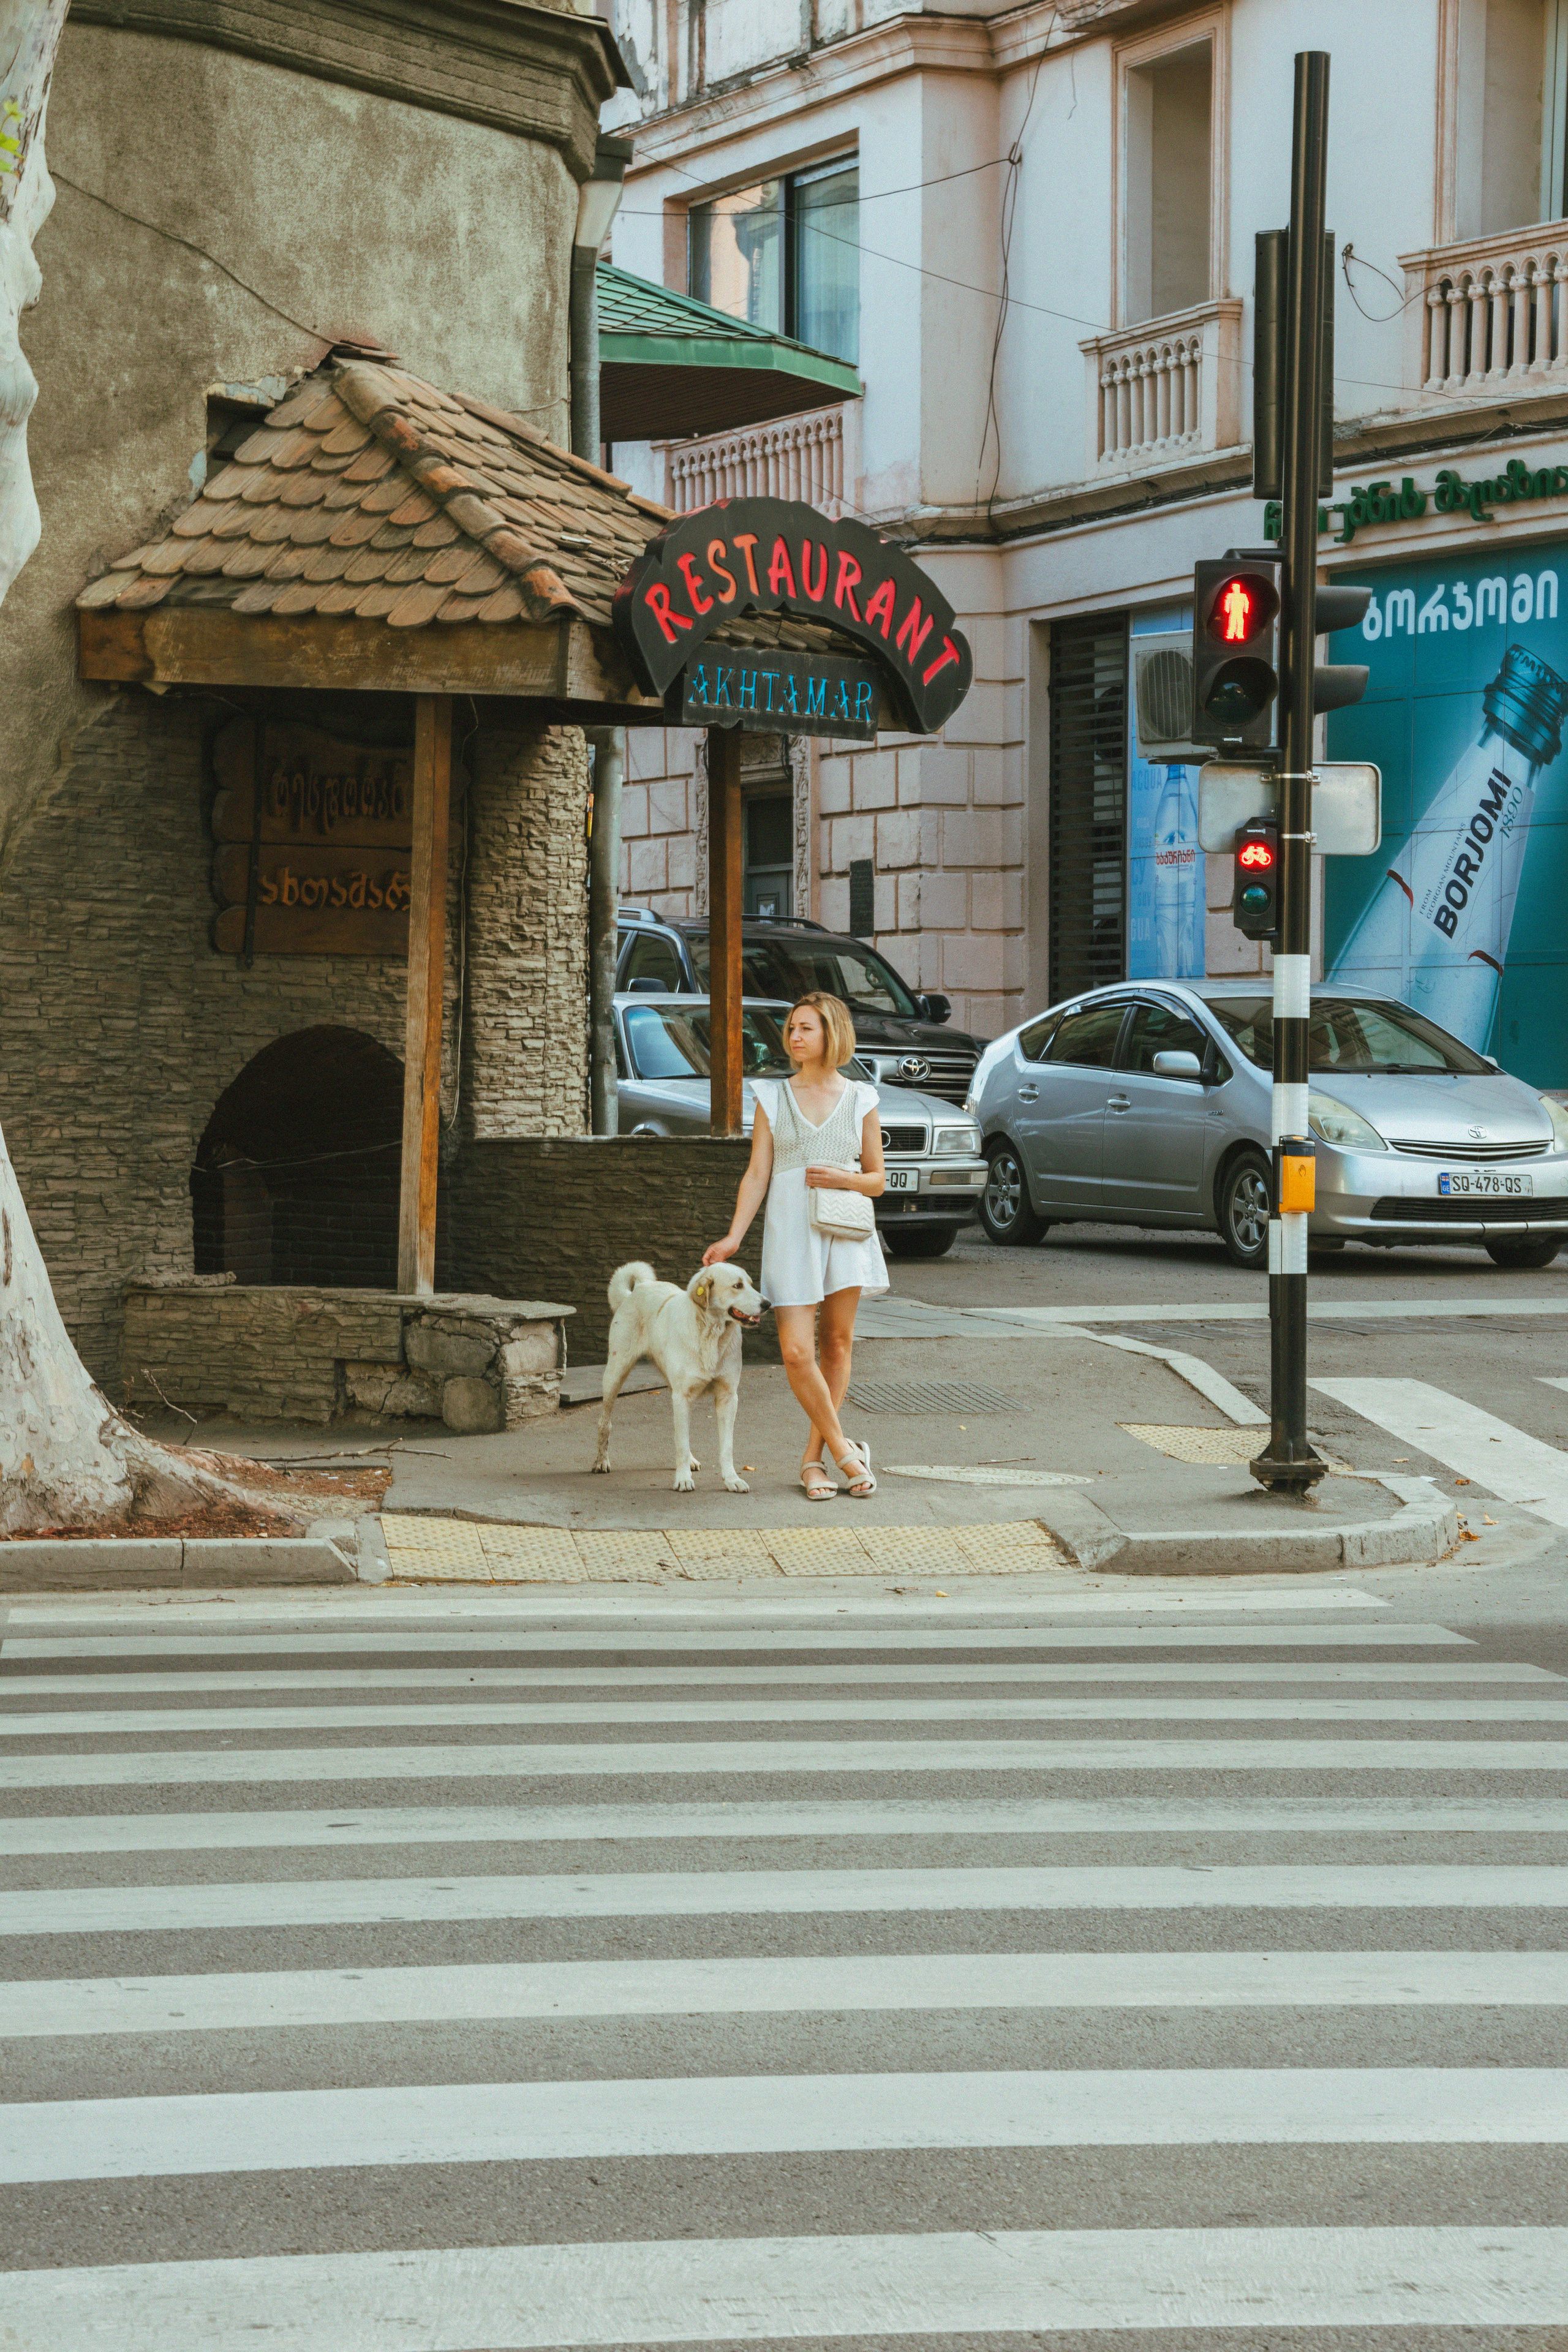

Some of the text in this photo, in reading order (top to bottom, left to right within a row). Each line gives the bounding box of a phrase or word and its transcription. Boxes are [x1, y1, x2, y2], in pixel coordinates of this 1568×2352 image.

[645, 533, 960, 686] RESTAURANT
[688, 663, 873, 723] AKHTAMAR
[1500, 786, 1523, 839] 1890
[1156, 849, 1196, 865] ბაკურიანი
[1427, 822, 1466, 919] GEORGIAN MOUNTAINS
[1433, 766, 1512, 940] BORJOMI
[1419, 889, 1433, 915] FROM
[1452, 1175, 1522, 1193] SQ-478-QS
